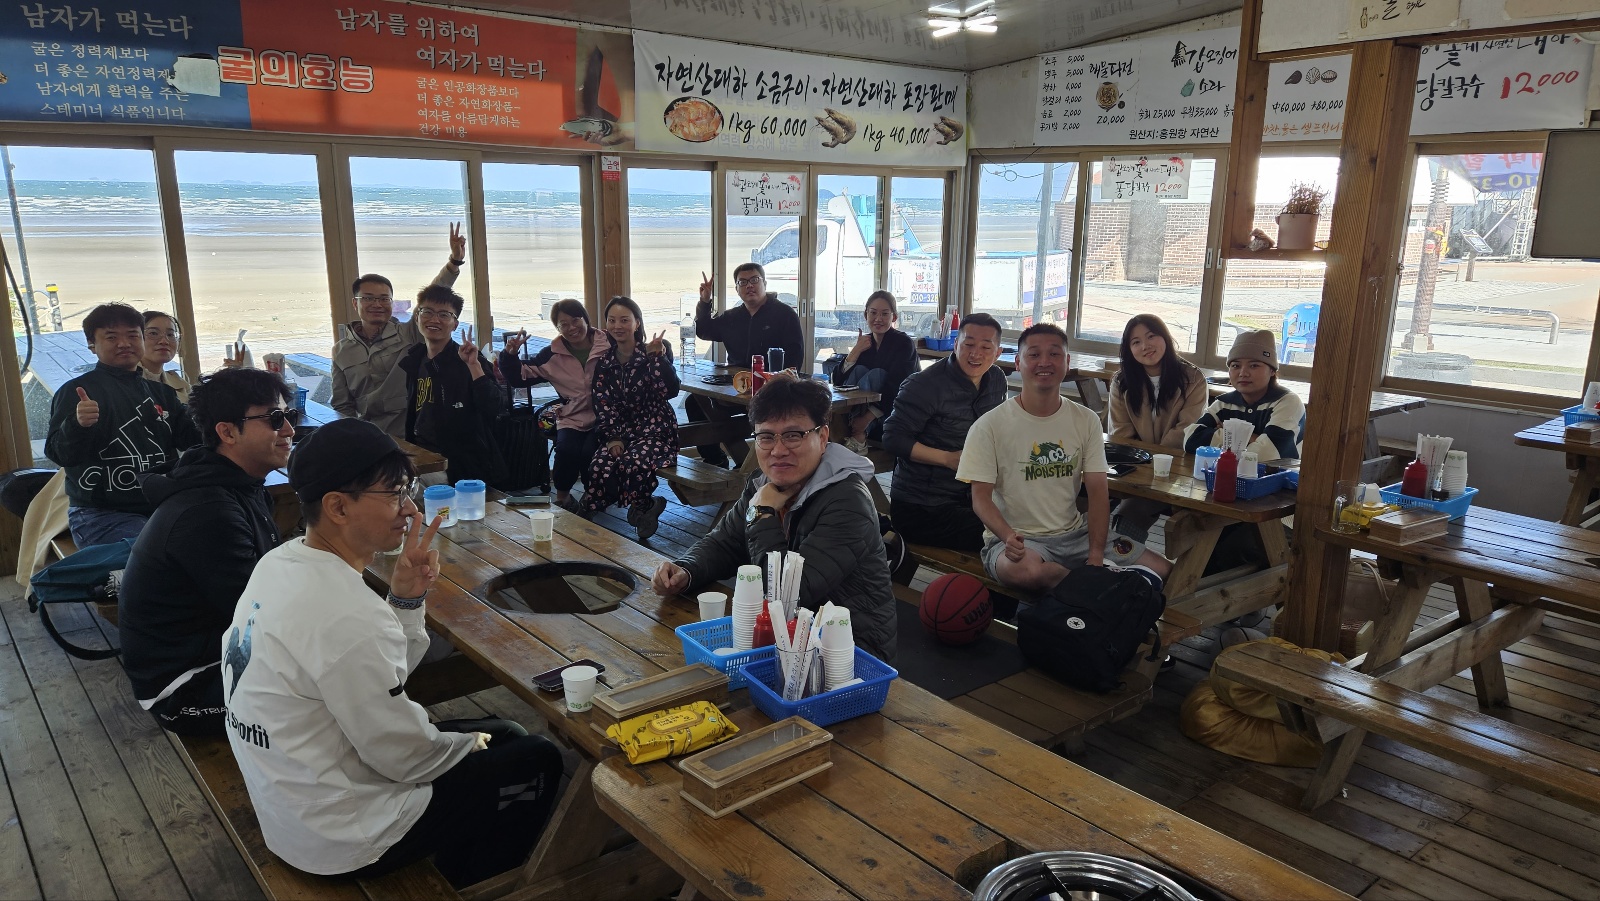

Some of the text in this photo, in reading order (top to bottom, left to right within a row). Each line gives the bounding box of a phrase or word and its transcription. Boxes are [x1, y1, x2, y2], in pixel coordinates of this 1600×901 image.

[20, 2, 193, 40] 남자가 먹는다
[335, 8, 480, 47] 남자를 위하여
[31, 41, 149, 61] 굴은 정력제보다
[34, 61, 49, 77] 더
[56, 63, 90, 79] 좋은
[217, 45, 375, 93] 굴의효능
[416, 46, 548, 81] 여자가 먹는다
[36, 81, 101, 98] 남자에게
[107, 84, 154, 99] 활력을
[416, 76, 440, 91] 굴은
[655, 58, 749, 100] 자연산대하
[756, 70, 811, 106] 소금구이
[1500, 70, 1580, 100] 12,000
[417, 92, 428, 105] 더
[433, 94, 455, 108] 좋은
[822, 72, 897, 110] 자연산대하
[903, 80, 958, 113] 포장판매
[40, 102, 186, 121] 스테미너 식품입니다
[417, 107, 452, 123] 여자를
[1096, 115, 1126, 126] 20,000
[419, 123, 468, 138] 건강 미용
[729, 111, 808, 143] 1kg 60,000
[1190, 126, 1220, 139] 자연산
[1300, 121, 1344, 136] 셀프입니
[863, 123, 931, 151] 1kg 40,000
[1025, 464, 1074, 481] MONSTER
